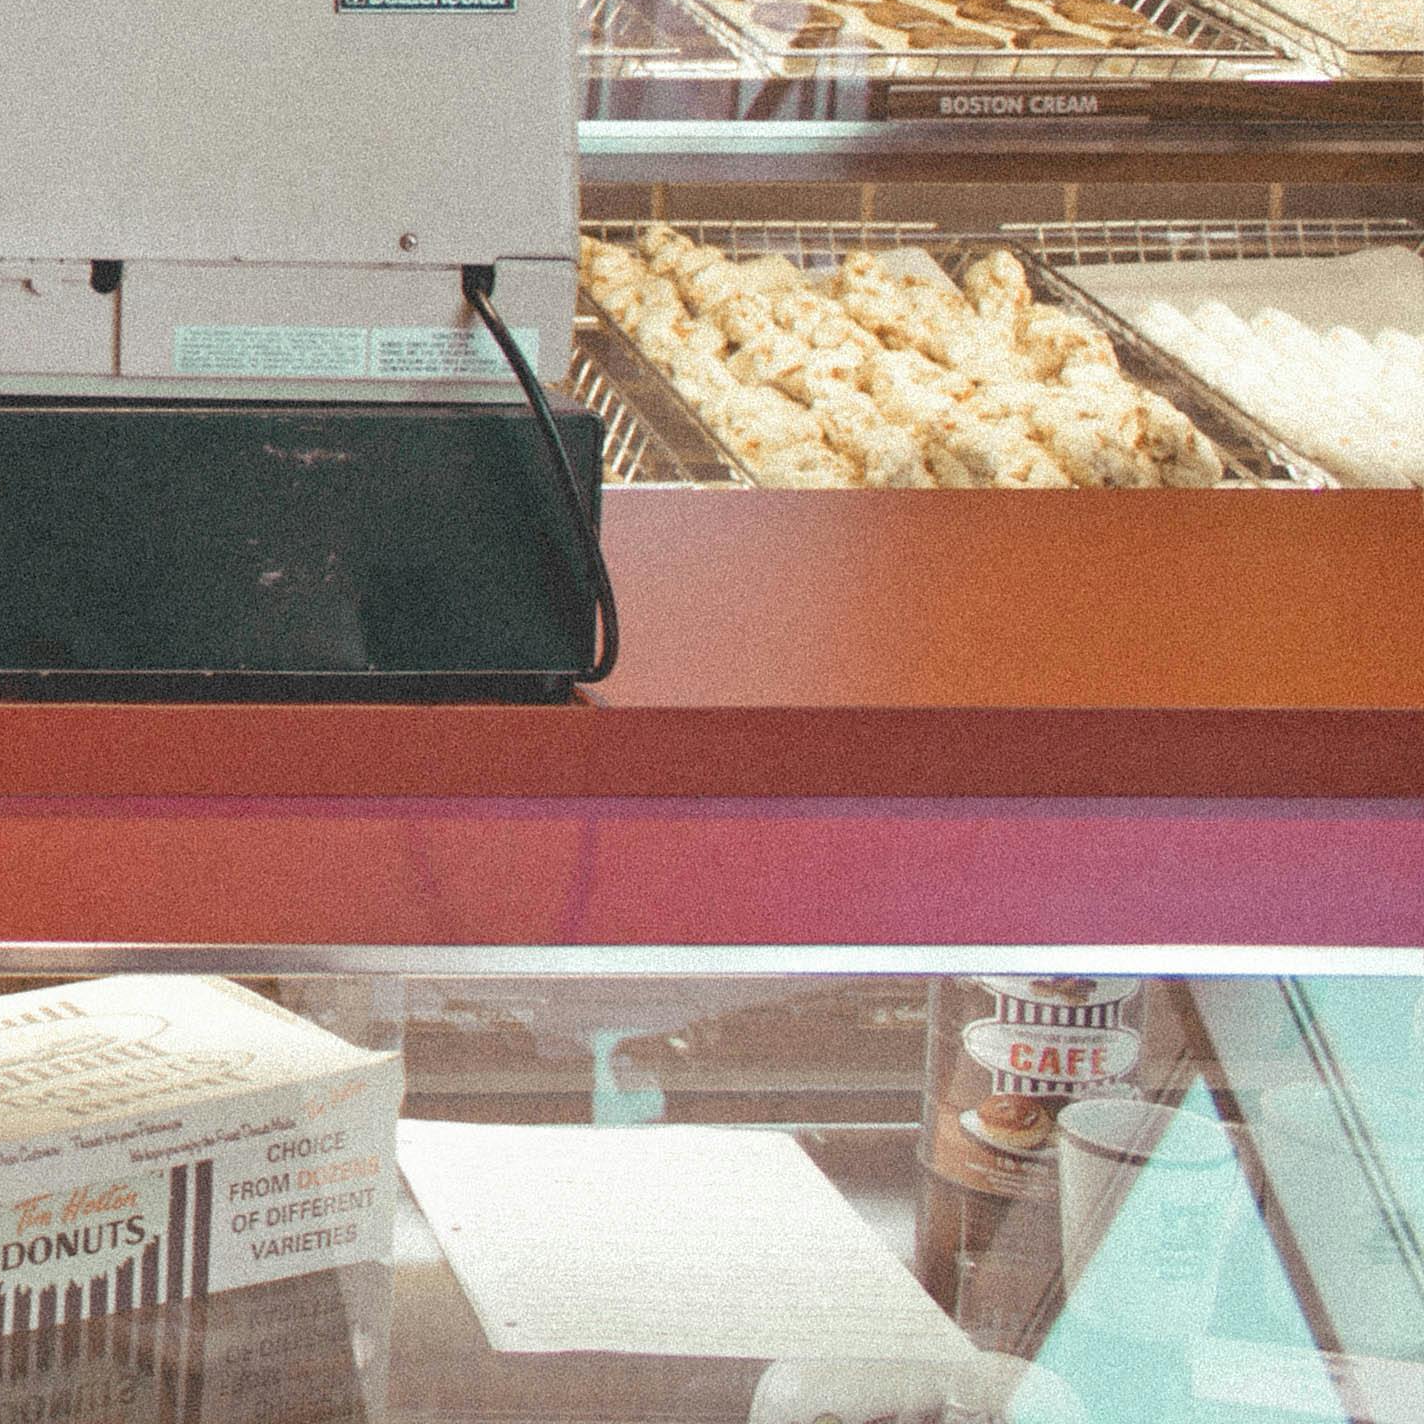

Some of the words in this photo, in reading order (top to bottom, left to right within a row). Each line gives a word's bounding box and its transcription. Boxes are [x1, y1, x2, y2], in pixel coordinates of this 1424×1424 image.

[940, 95, 1023, 114] BOSTON
[1028, 95, 1099, 114] CREAM
[265, 1129, 348, 1165] CHOICE
[229, 1170, 291, 1206] FROM
[296, 1153, 381, 1192] DOZENS
[13, 1188, 58, 1237] Tim
[60, 1180, 140, 1226] Horton
[231, 1209, 260, 1236] OF
[265, 1186, 374, 1231] DIFFERENT
[0, 1215, 147, 1275] DONUTS
[250, 1222, 358, 1262] VARIETIES
